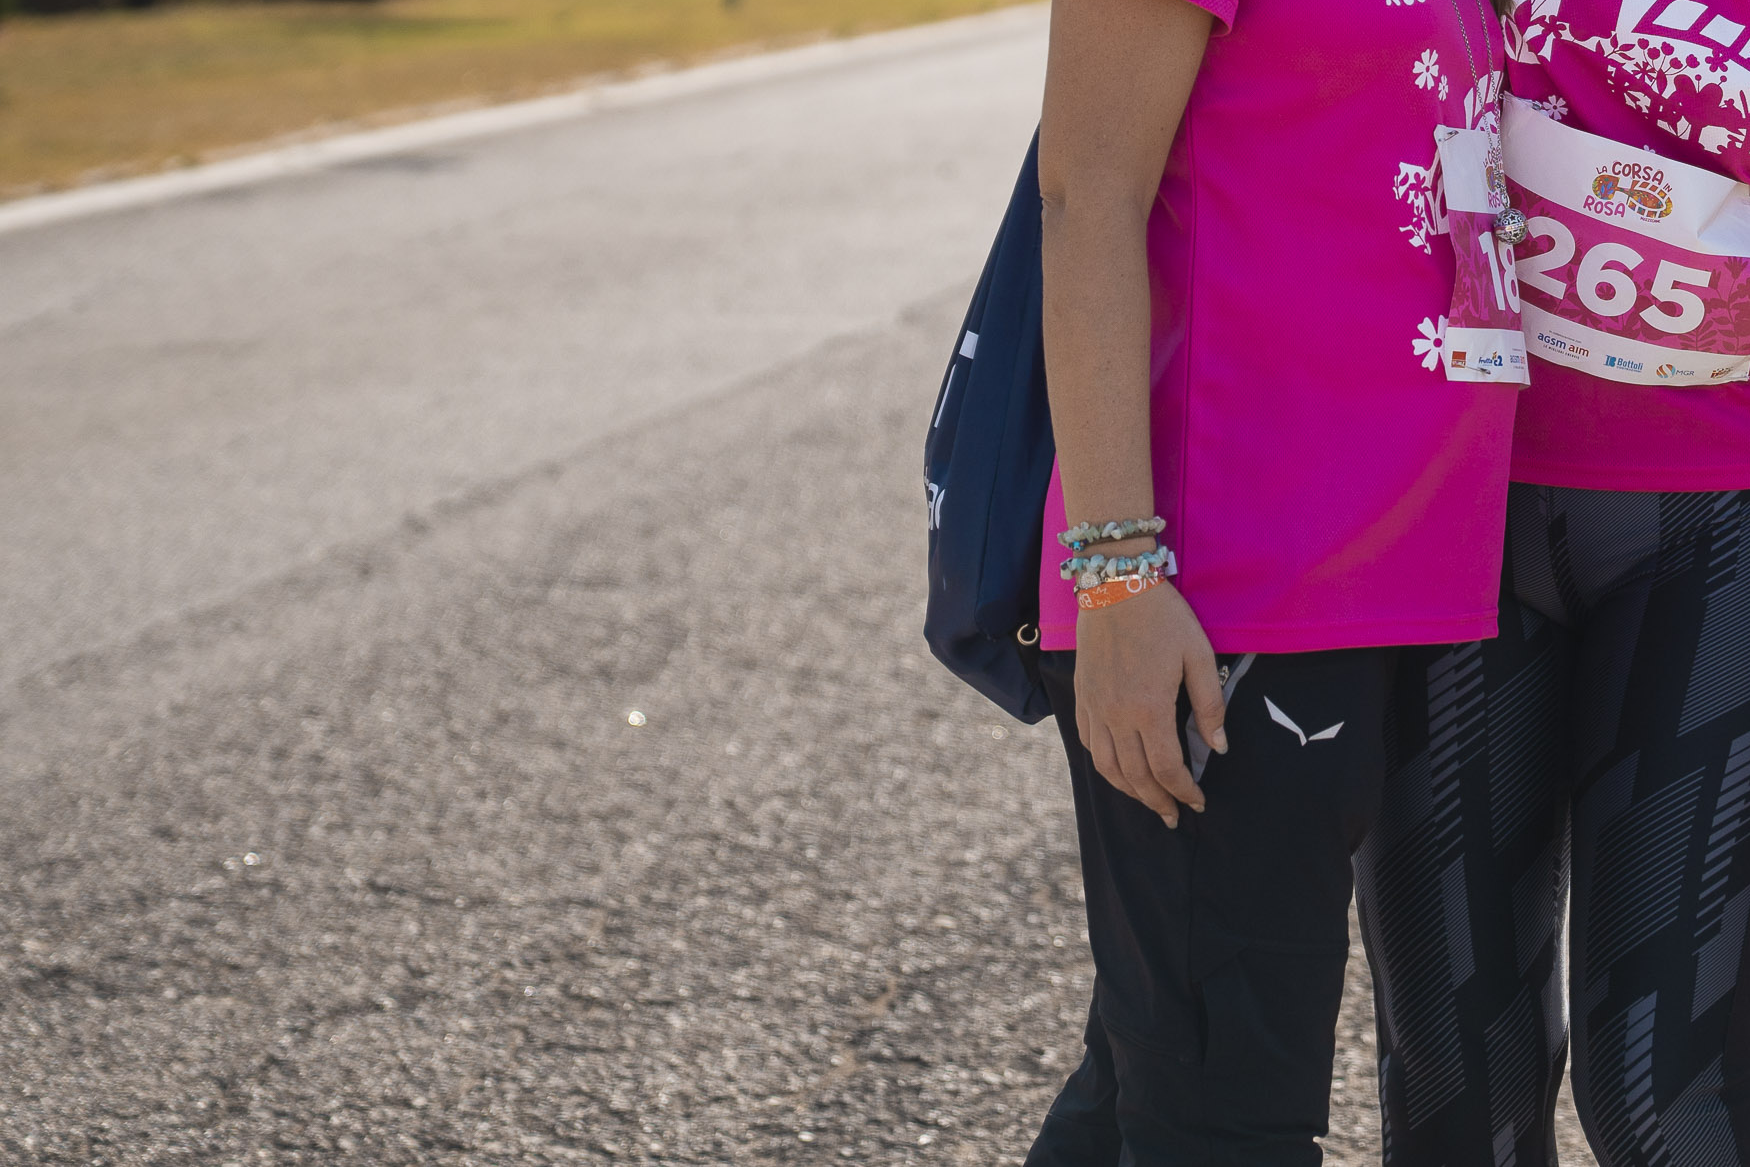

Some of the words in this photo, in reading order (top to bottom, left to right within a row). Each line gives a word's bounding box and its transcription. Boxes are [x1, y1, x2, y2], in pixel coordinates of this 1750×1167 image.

[1596, 166, 1608, 175] LA
[1611, 161, 1664, 186] CORSA
[1662, 183, 1673, 193] IN
[1583, 194, 1626, 218] ROSA
[1515, 216, 1712, 334] 265
[1568, 344, 1590, 357] aim
[1617, 357, 1644, 370] Bottoli
